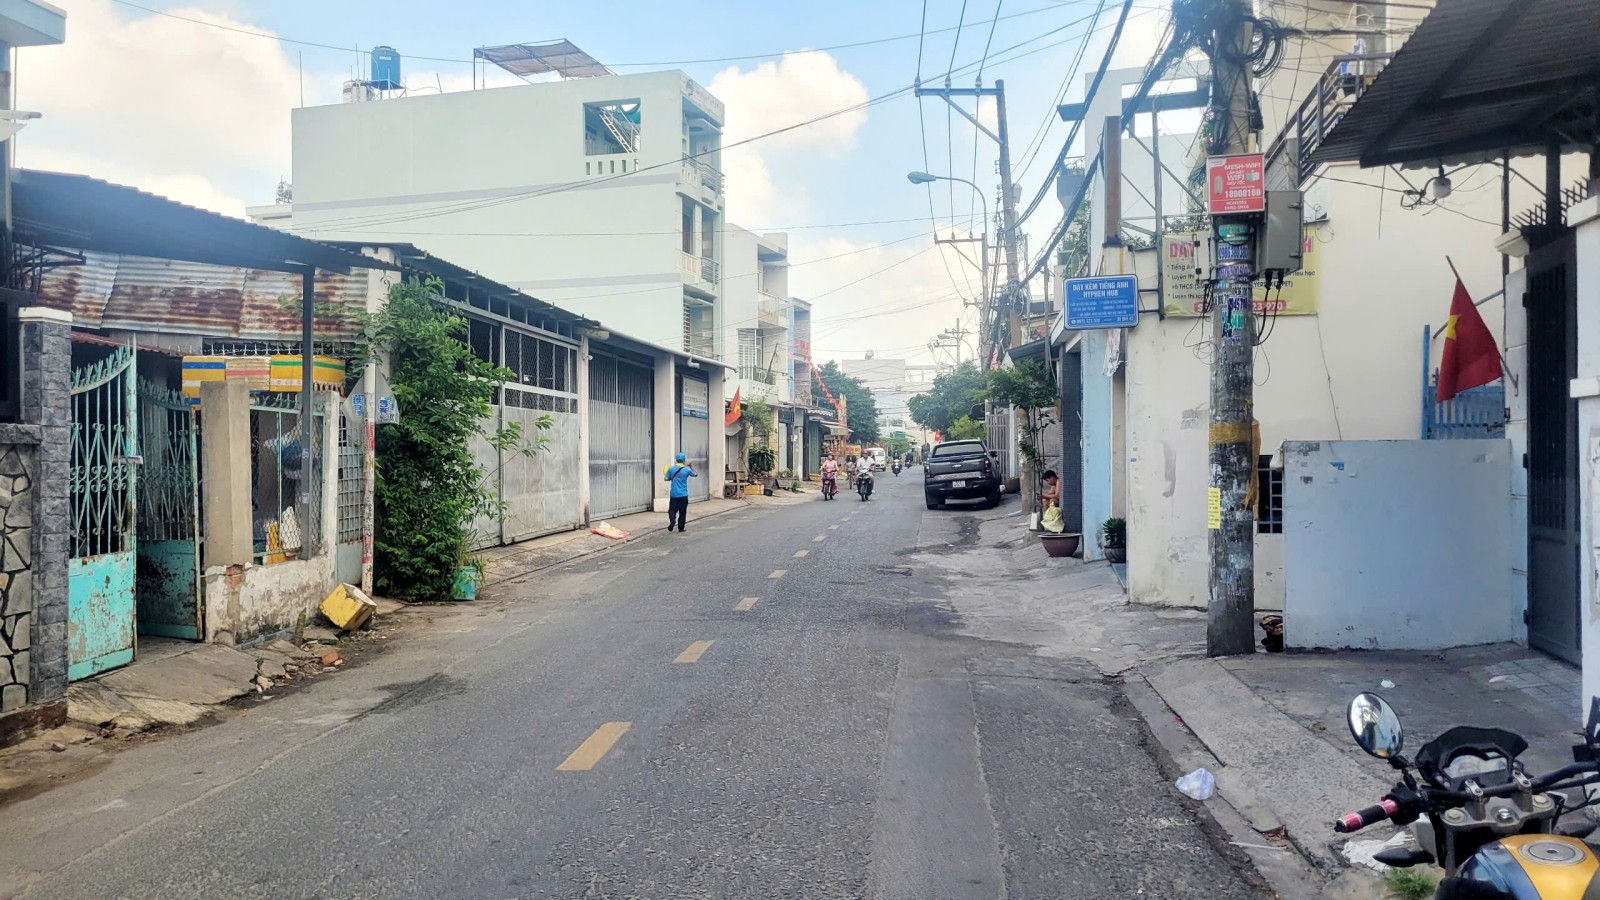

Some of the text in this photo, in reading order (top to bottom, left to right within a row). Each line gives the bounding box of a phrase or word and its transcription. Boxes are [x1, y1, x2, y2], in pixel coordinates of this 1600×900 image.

[1171, 263, 1185, 271] Tiếng
[1073, 284, 1084, 292] DẠY
[1099, 281, 1115, 289] TIẾNG
[1083, 289, 1118, 298] HYPHEN HUB
